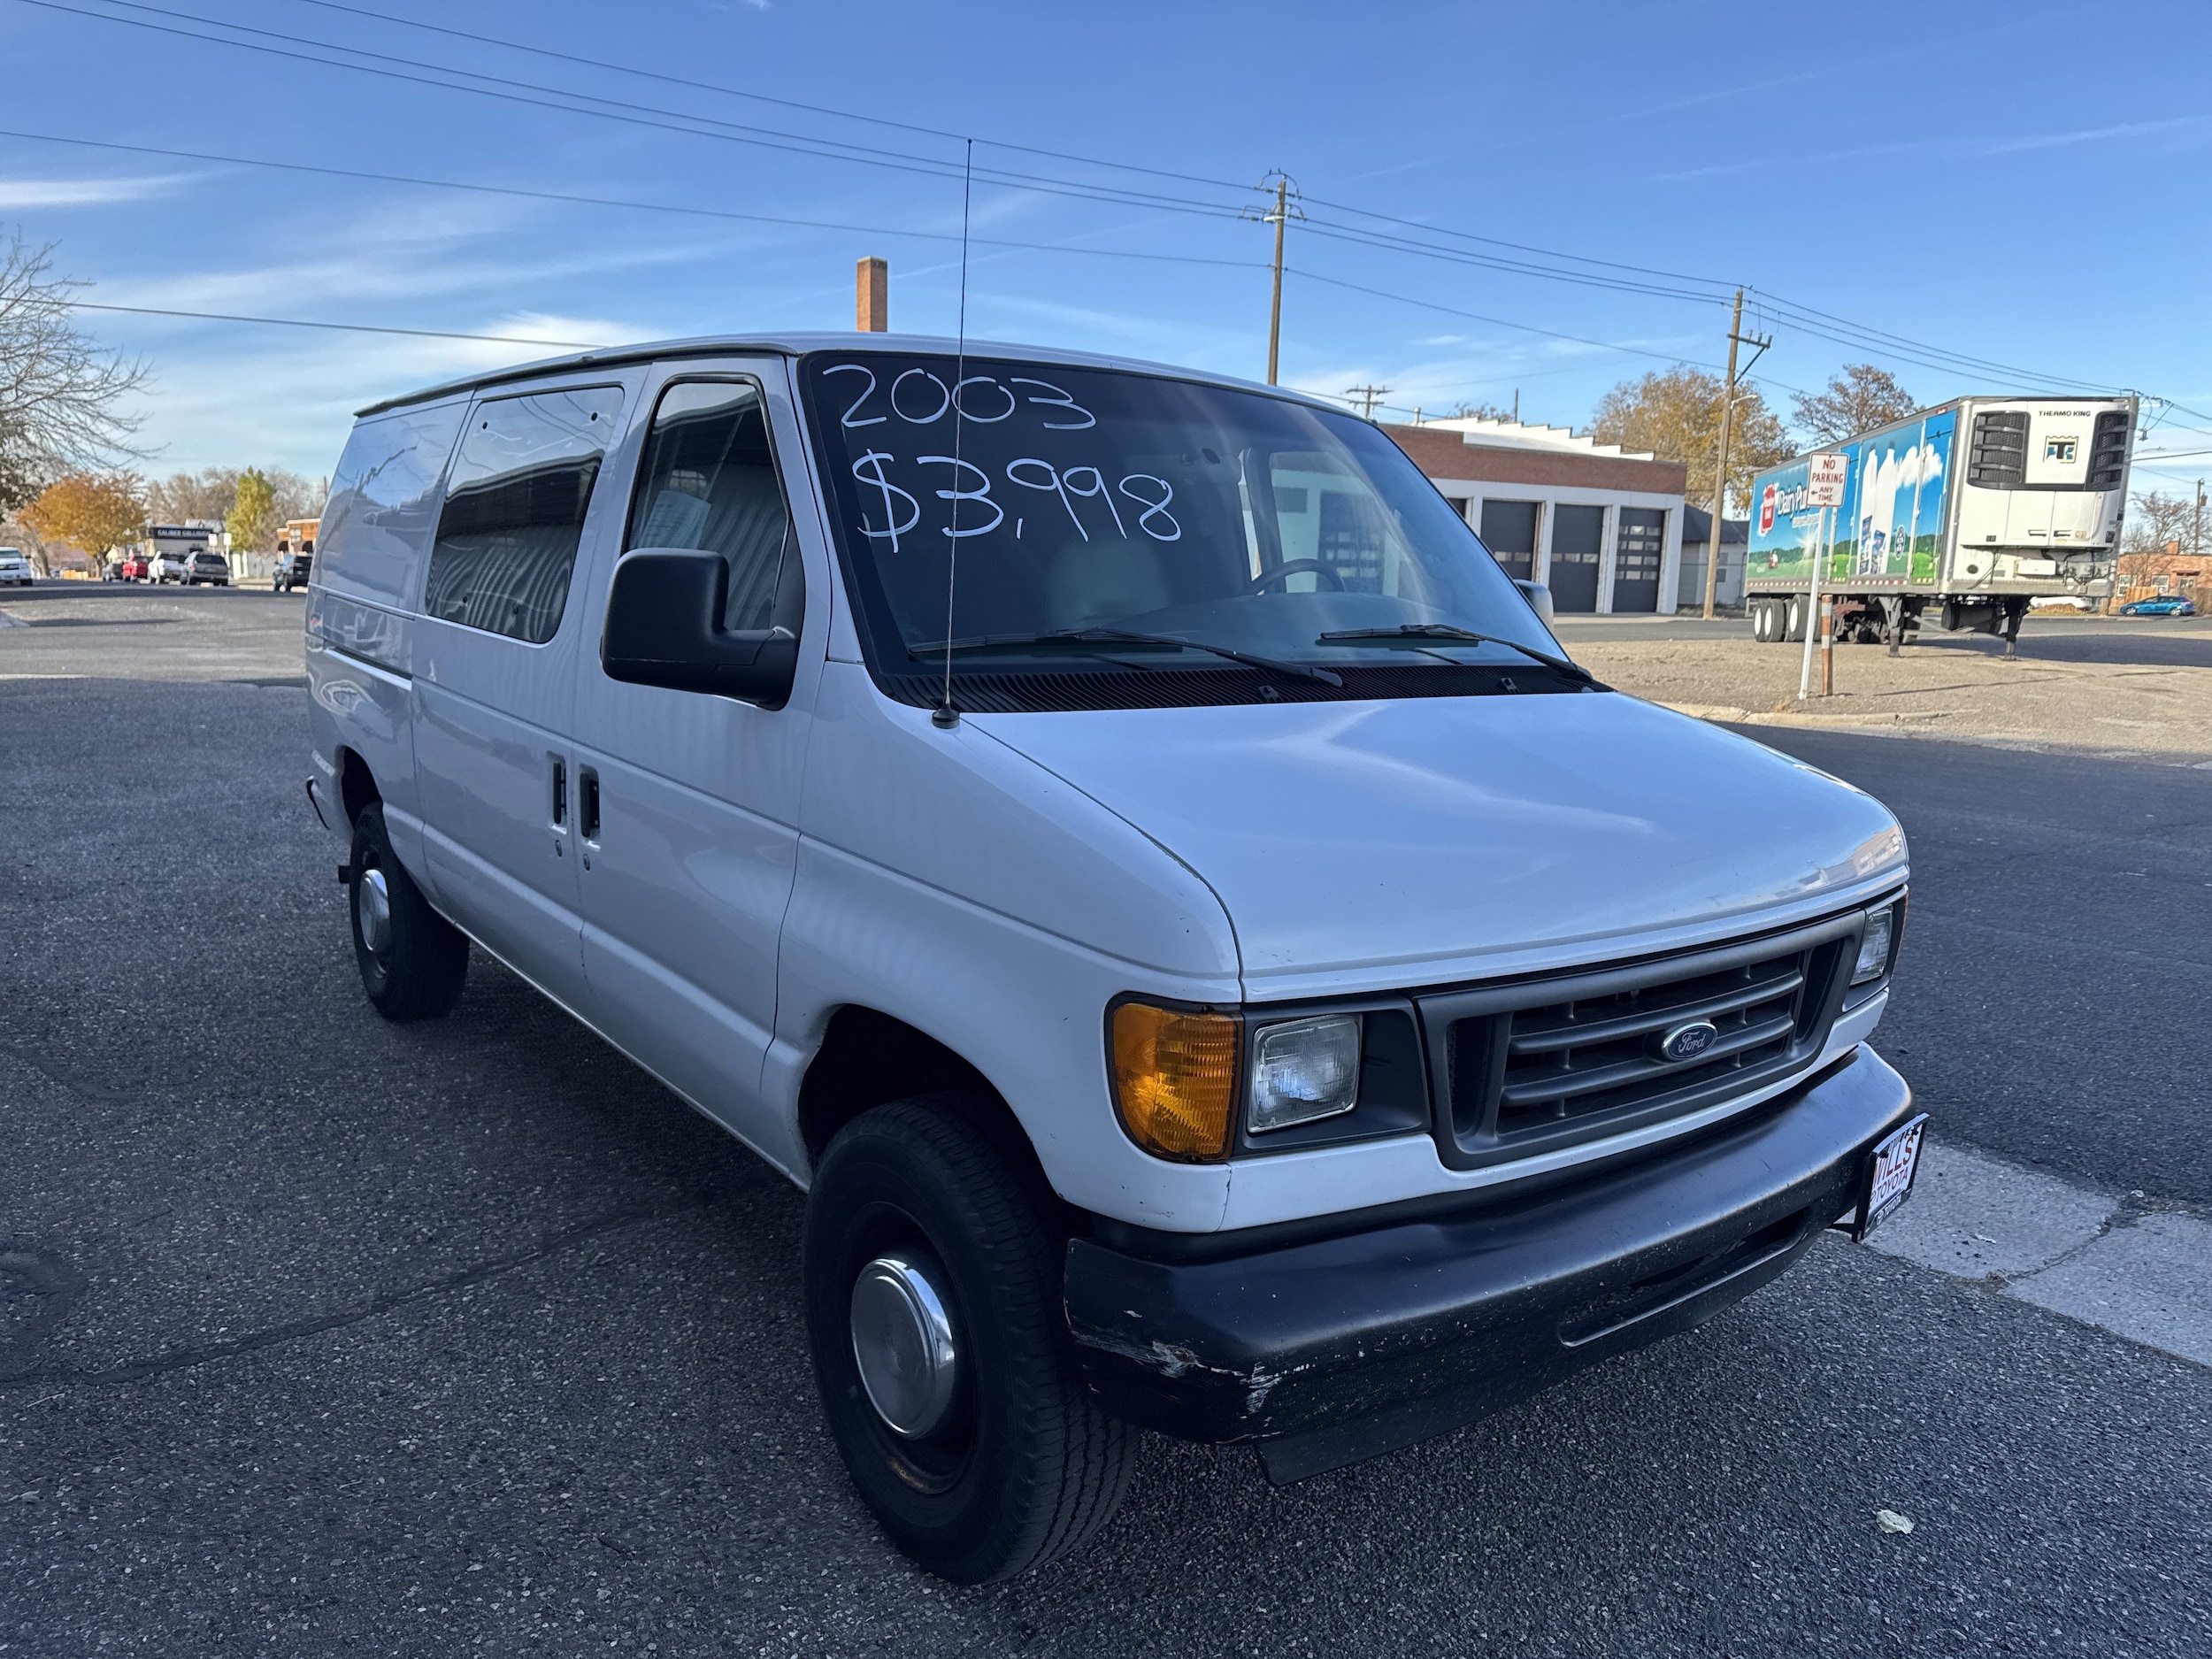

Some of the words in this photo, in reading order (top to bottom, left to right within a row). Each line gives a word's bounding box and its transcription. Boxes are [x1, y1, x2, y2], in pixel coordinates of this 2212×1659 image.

[822, 364, 1097, 430] 2003
[1811, 472, 1844, 484] PARKING
[1823, 459, 1836, 470] NO
[851, 448, 1182, 554] $3,998
[1678, 1030, 1707, 1054] Ford
[1876, 1167, 1909, 1203] TOYOTA
